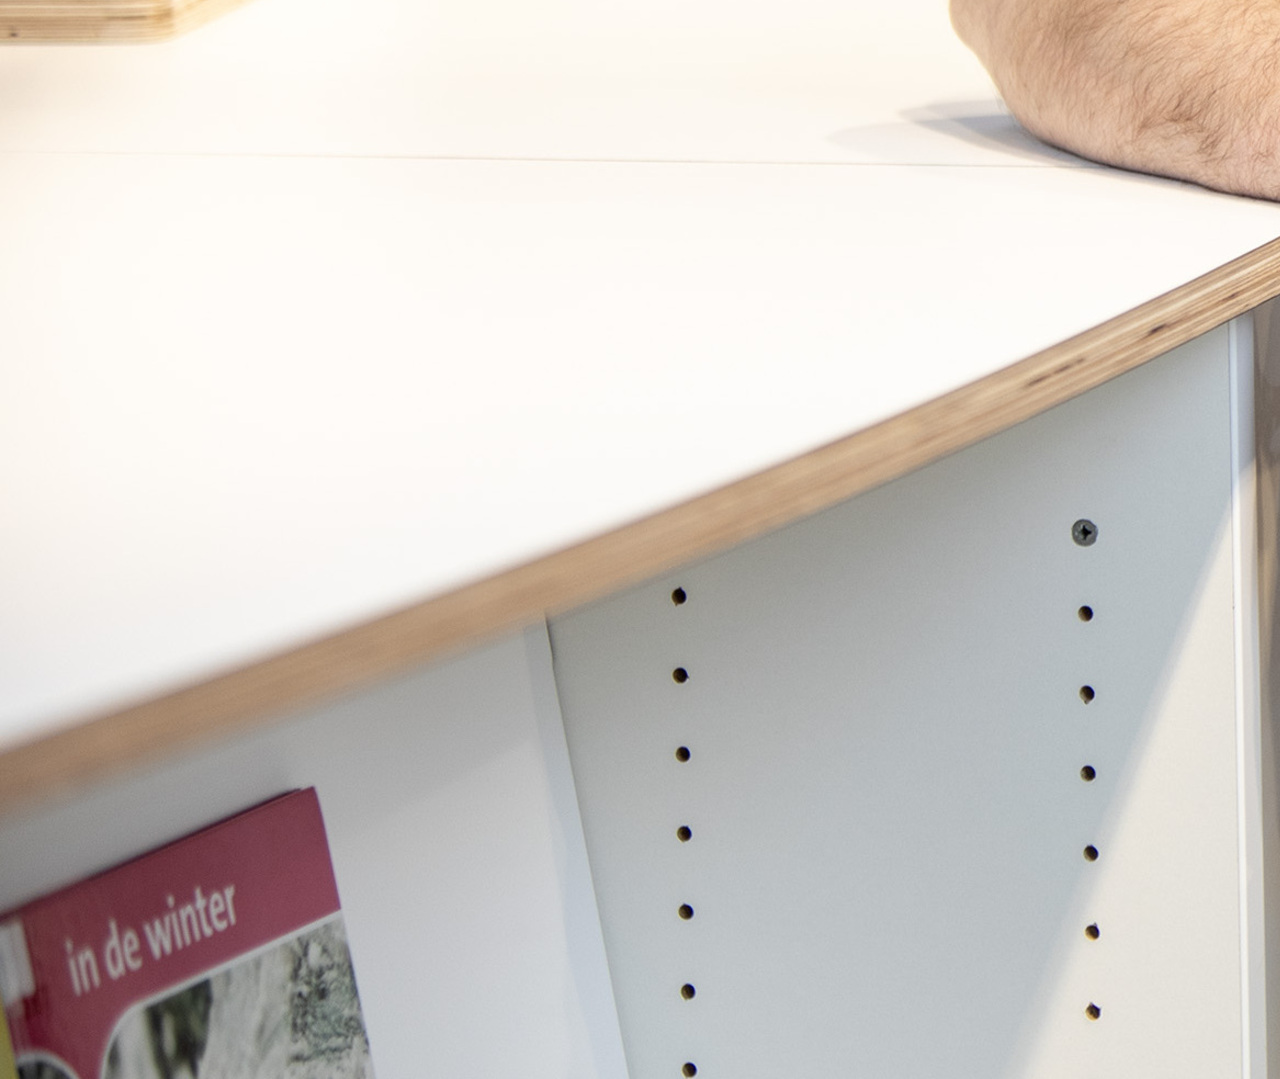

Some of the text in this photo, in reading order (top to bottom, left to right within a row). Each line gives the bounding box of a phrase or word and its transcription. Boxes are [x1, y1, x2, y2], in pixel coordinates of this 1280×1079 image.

[65, 884, 237, 996] in de winter
